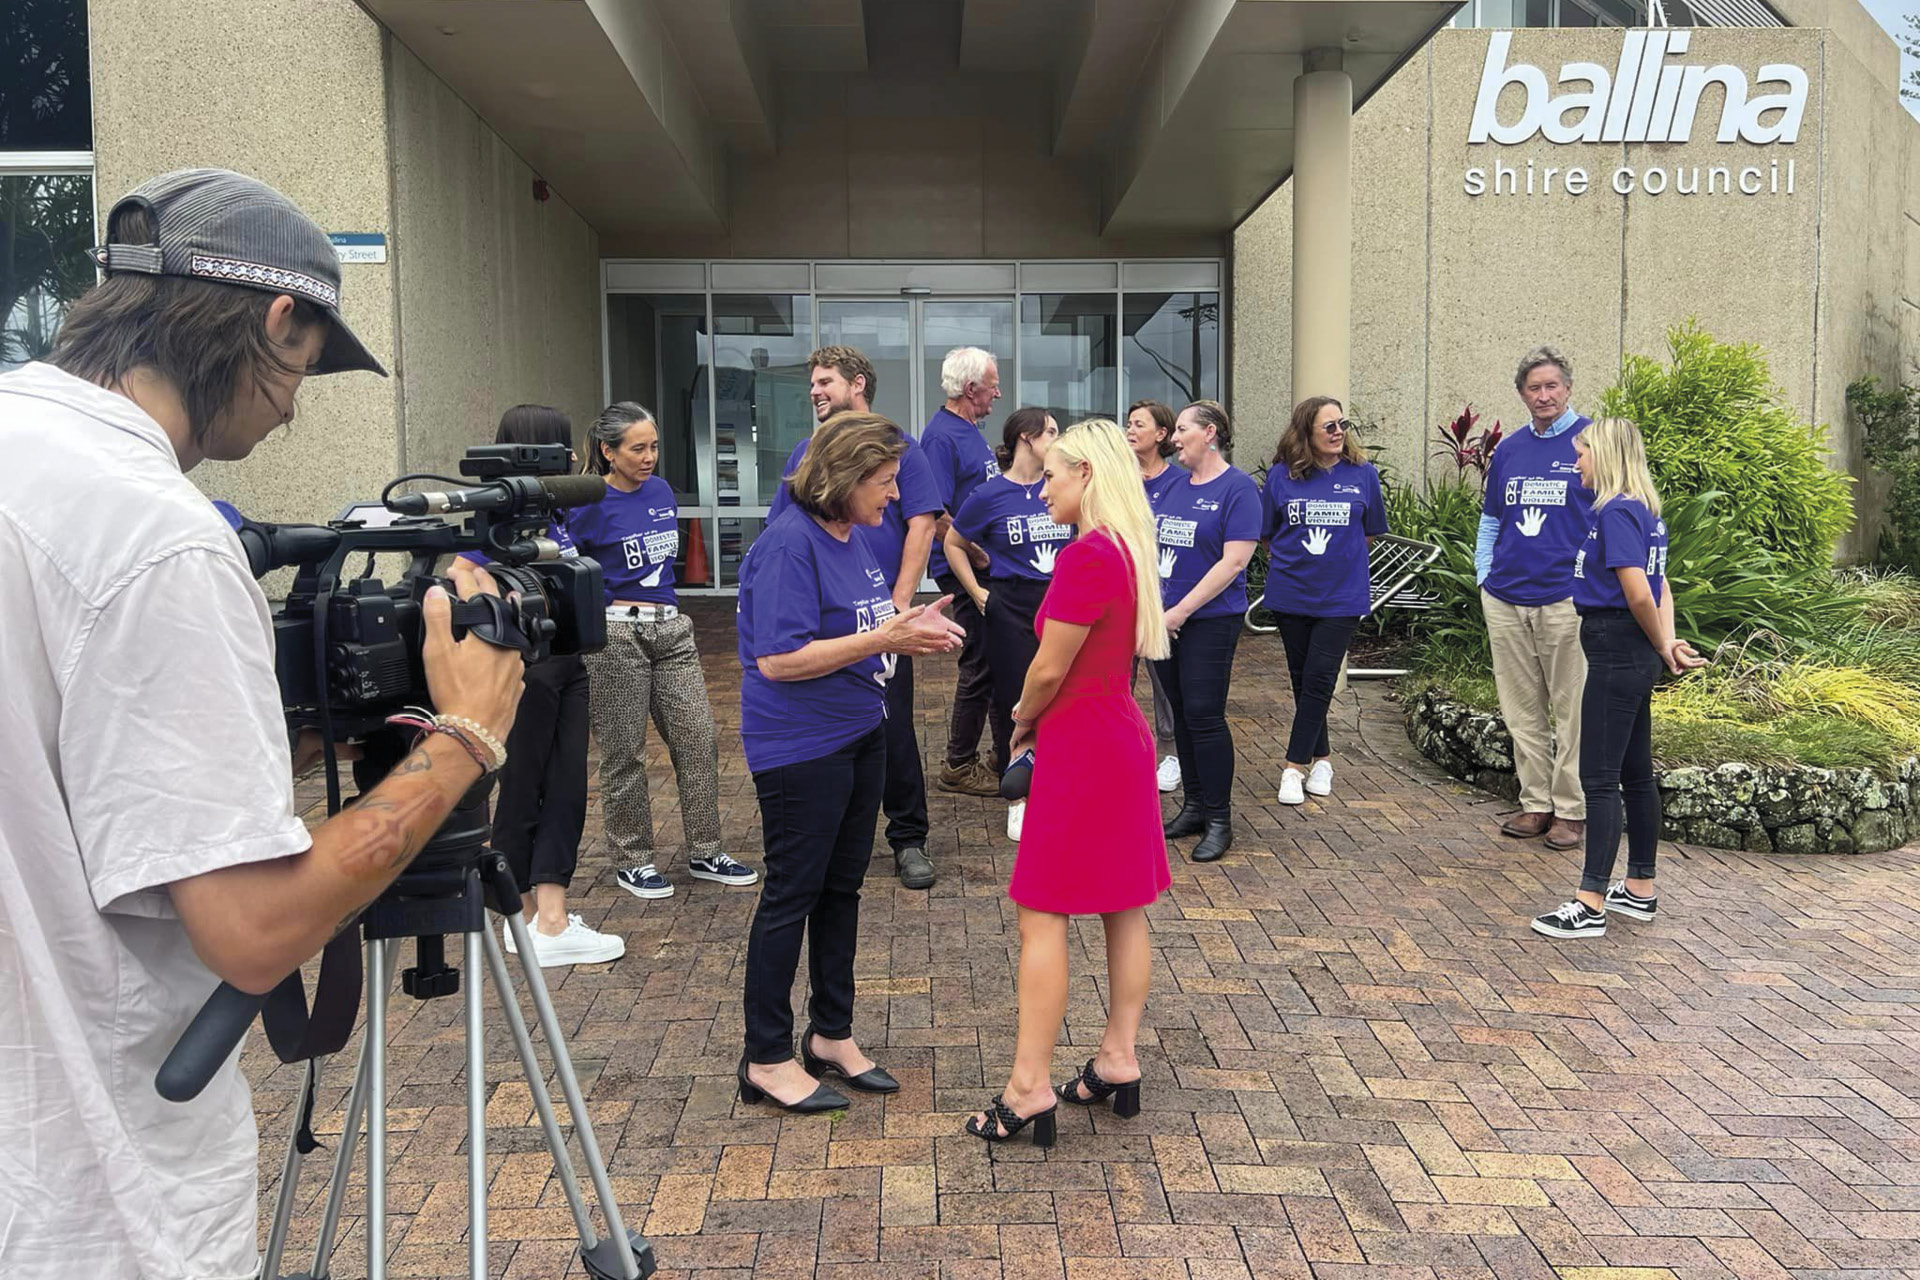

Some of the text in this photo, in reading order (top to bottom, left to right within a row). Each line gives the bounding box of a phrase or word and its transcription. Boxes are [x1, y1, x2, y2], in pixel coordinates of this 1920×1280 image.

[1467, 31, 1809, 145] ballina
[1464, 159, 1796, 196] shire council
[348, 249, 377, 260] Street
[1507, 482, 1516, 504] NO
[1290, 503, 1299, 524] NO
[645, 531, 677, 545] DOMESTIC
[1009, 521, 1021, 543] NO
[1160, 528, 1194, 537] FAMILY
[1160, 535, 1194, 546] VIOLENCE
[625, 541, 641, 567] NO
